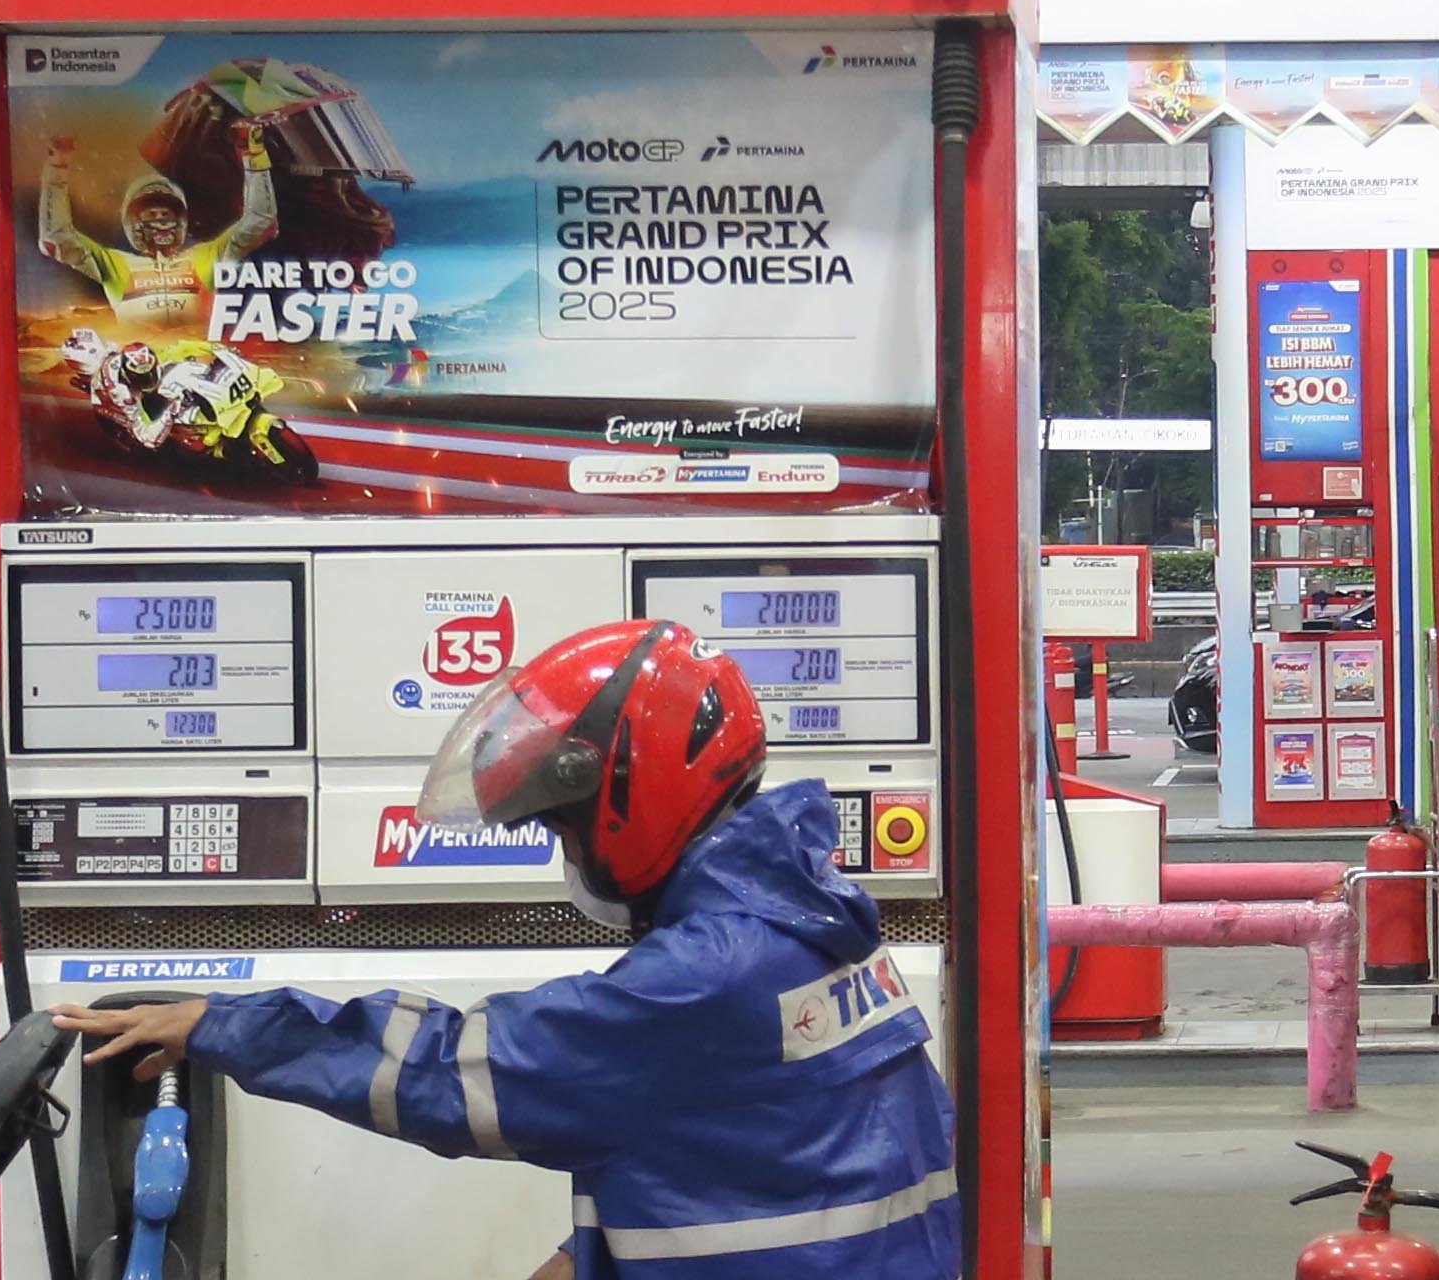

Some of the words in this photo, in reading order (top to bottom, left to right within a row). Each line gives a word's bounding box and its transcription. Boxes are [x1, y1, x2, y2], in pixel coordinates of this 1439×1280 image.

[51, 48, 121, 61] Danantara
[842, 56, 917, 69] PERTAMINA
[51, 60, 117, 73] Indonesia
[536, 137, 685, 164] MotoGP
[736, 145, 806, 157] PERTAMINA
[556, 184, 824, 216] PERTAMINA
[556, 220, 708, 250] GRAND
[717, 220, 830, 250] PRIX
[213, 261, 303, 290] DARE
[308, 261, 356, 290] TO
[361, 261, 418, 290] GO
[557, 255, 614, 286] OF
[624, 255, 854, 286] INDONESIA
[558, 291, 677, 322] 2025
[207, 293, 419, 343] FASTER
[1300, 337, 1335, 352] BBM
[1266, 356, 1303, 370] LEBIH
[1304, 356, 1354, 370] HEMAT
[1272, 376, 1349, 407] 300
[605, 416, 677, 448] Energy
[681, 418, 695, 434] to
[696, 420, 732, 434] move
[735, 406, 804, 438] Faster!
[676, 466, 751, 483] MyPERTAMINA
[757, 470, 825, 483] Enduro
[21, 530, 89, 544] TATSUNO
[426, 592, 494, 602] PERTAMINA
[136, 599, 214, 630] 25000
[425, 603, 450, 612] CALL
[454, 604, 494, 612] CENTER
[758, 592, 837, 625] 20000
[427, 631, 503, 674] 135
[173, 713, 216, 735] 12300
[795, 707, 838, 728] 10000
[874, 795, 928, 805] EMERGENCY
[889, 857, 914, 868] STOP
[87, 961, 230, 979] PERTAMAX
